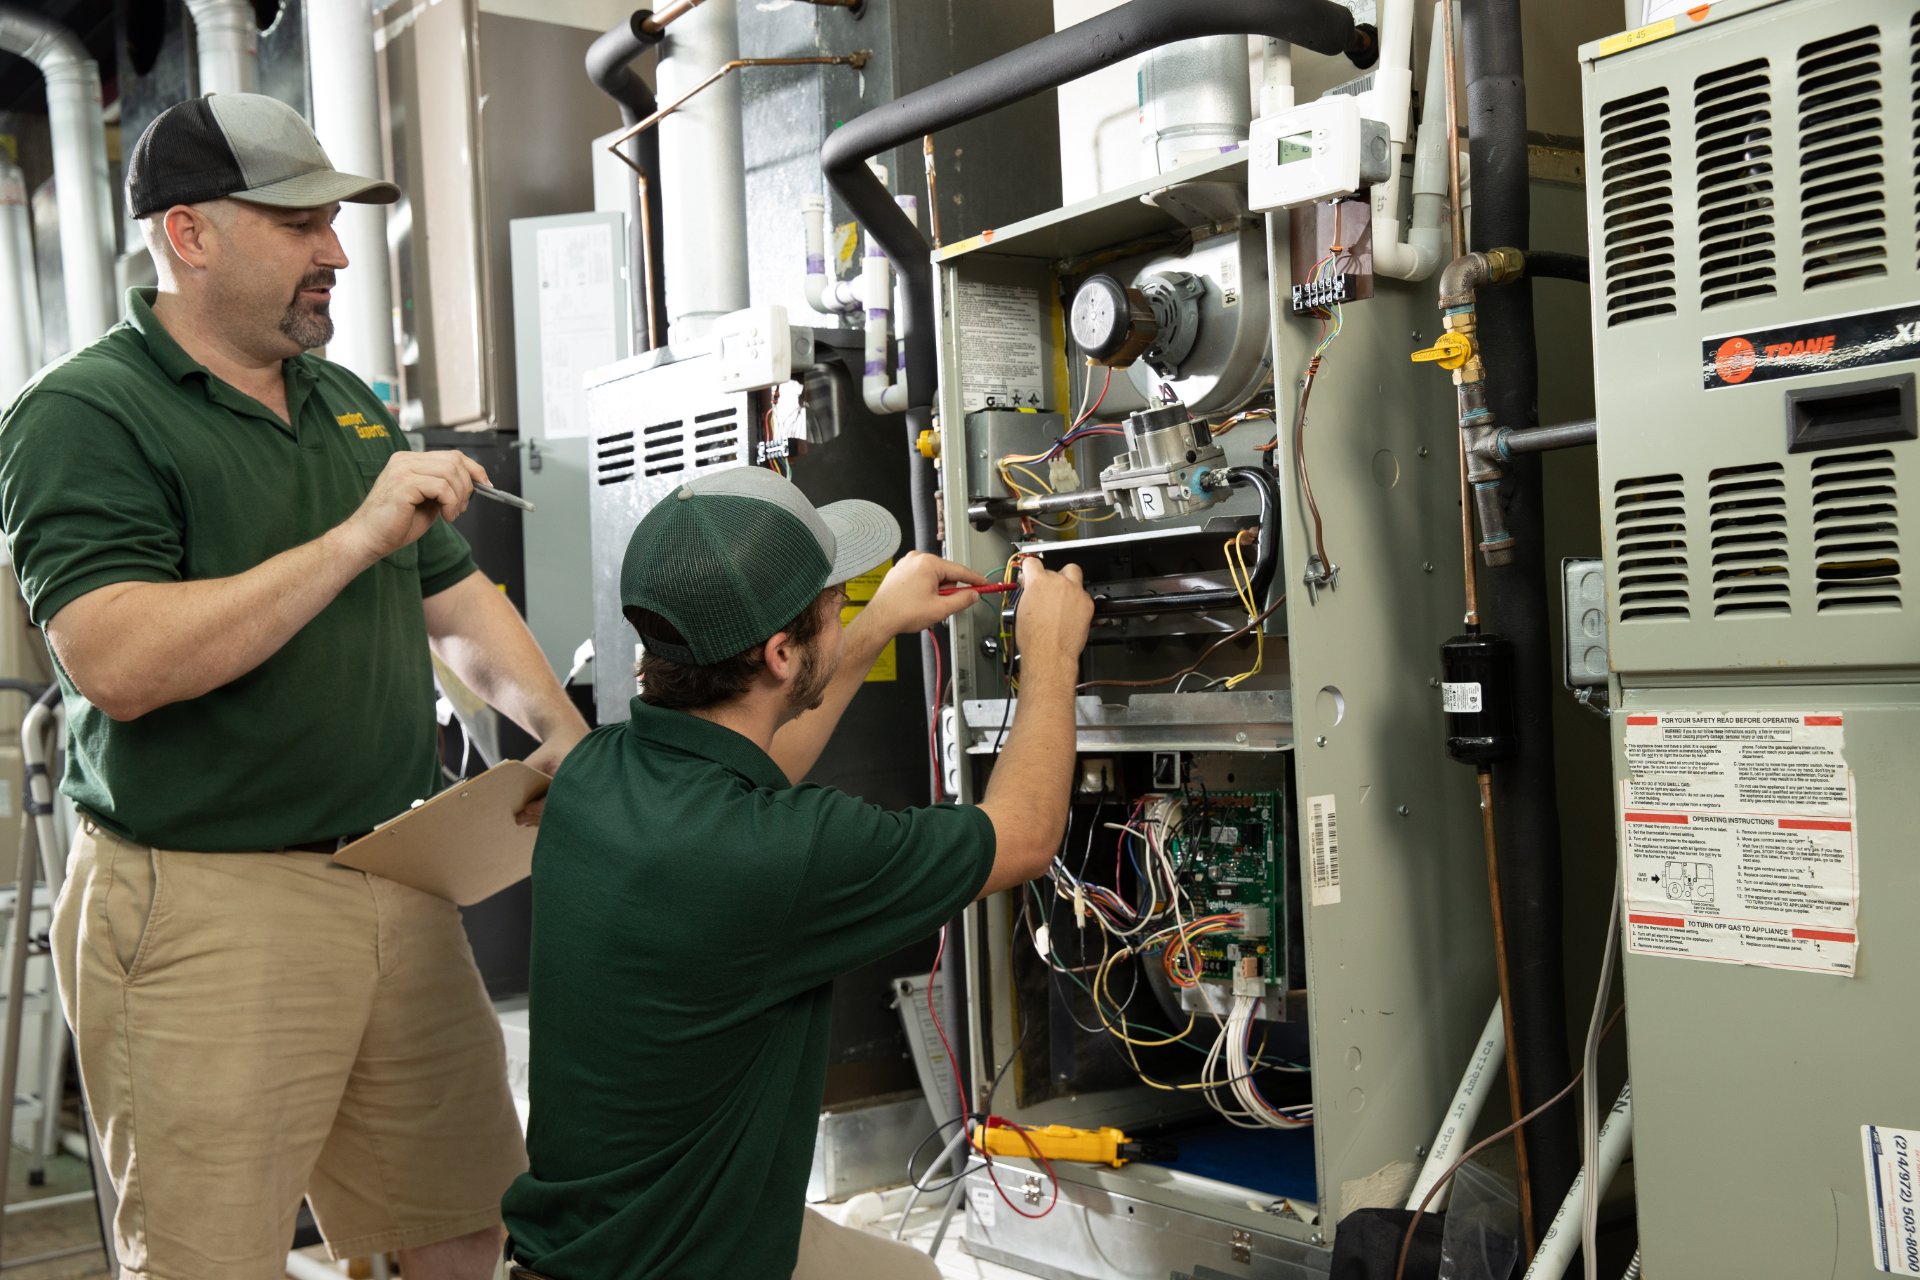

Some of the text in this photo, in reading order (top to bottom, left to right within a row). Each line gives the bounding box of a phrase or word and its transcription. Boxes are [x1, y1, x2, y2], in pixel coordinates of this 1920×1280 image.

[1763, 335, 1836, 359] TRANE
[1142, 494, 1155, 511] R
[1693, 816, 1775, 825] OPERATING INSTRUCTIONS
[1752, 926, 1788, 936] APPLIANCE
[1435, 1040, 1495, 1161] Made in America
[1894, 1135, 1913, 1203] (214/972)
[1902, 1206, 1920, 1272] 503-8000
